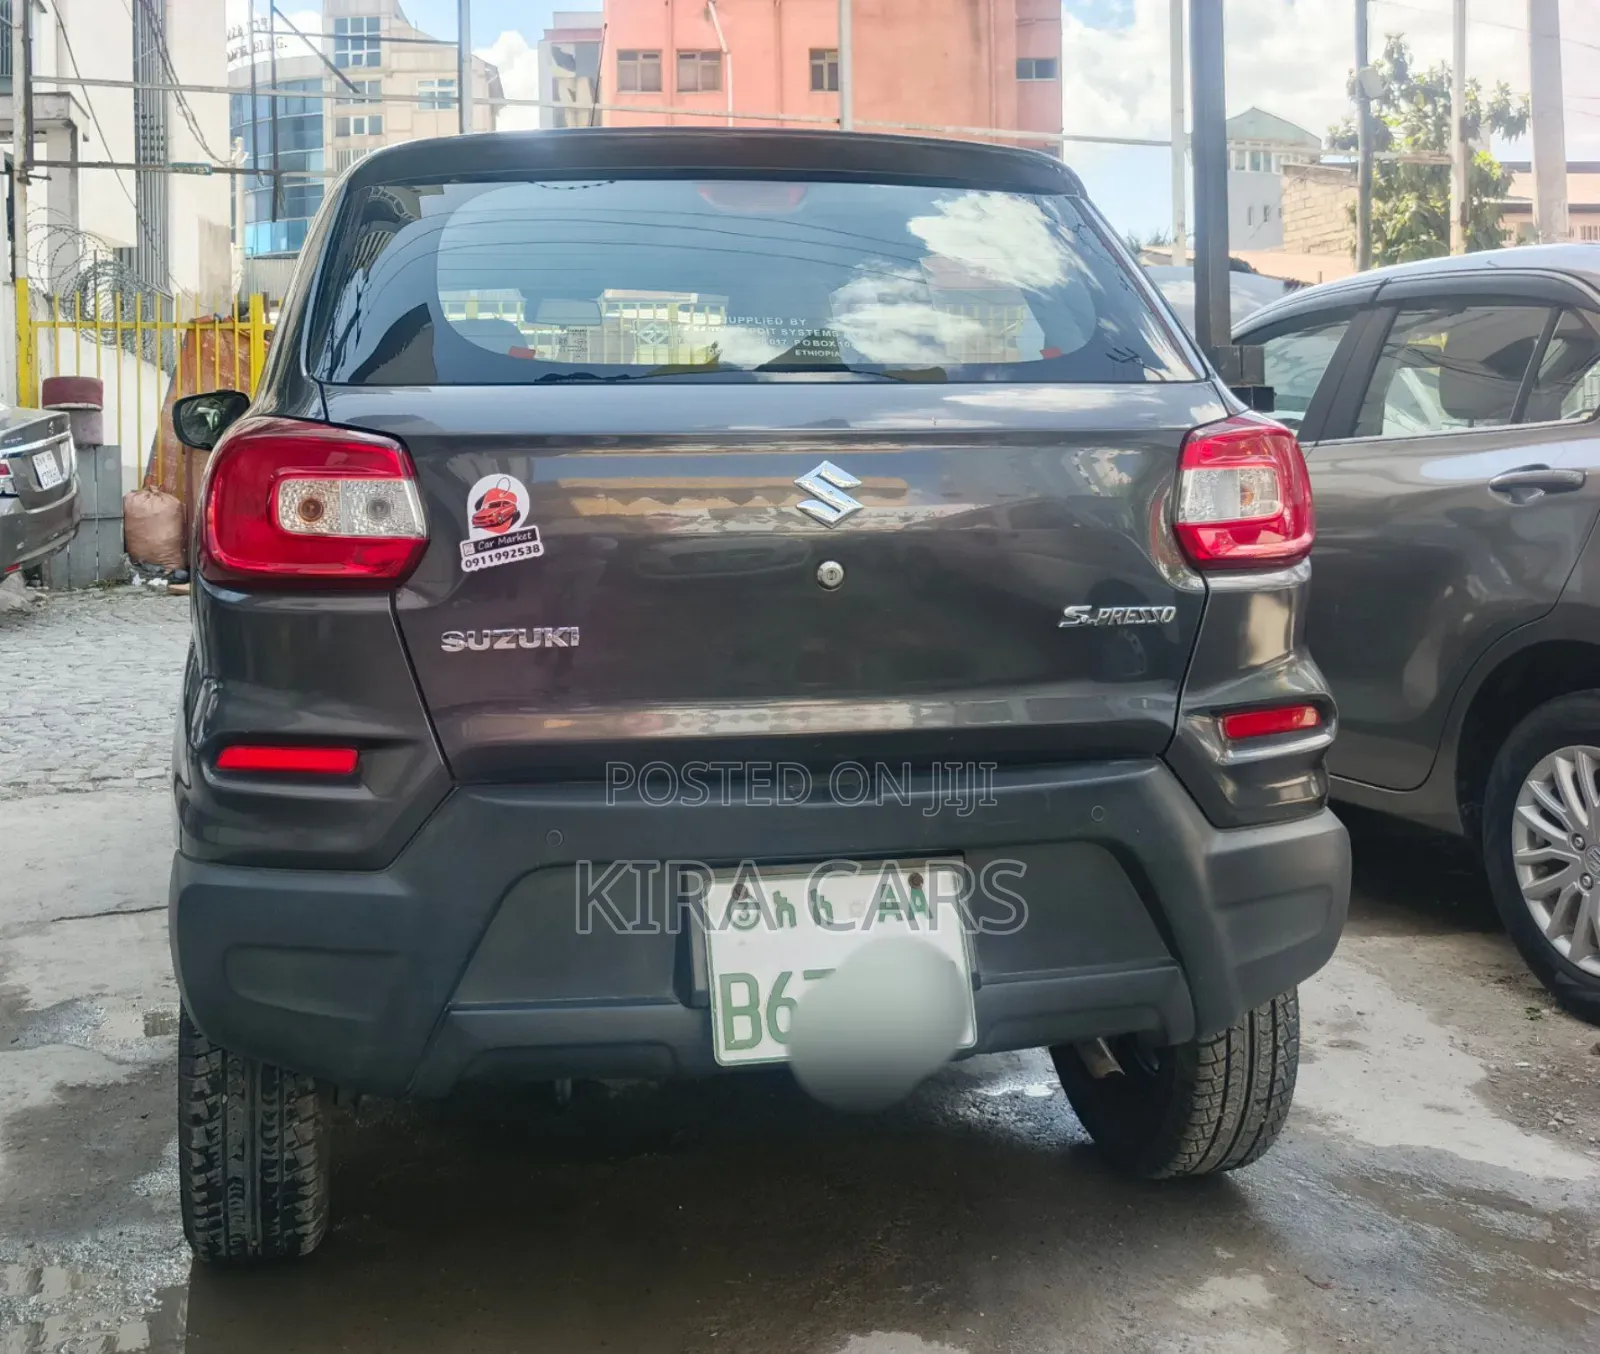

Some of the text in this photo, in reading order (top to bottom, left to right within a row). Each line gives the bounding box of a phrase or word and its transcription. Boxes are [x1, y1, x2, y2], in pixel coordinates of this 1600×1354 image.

[795, 349, 841, 358] ETHIOPIA
[478, 531, 533, 551] Car Market
[465, 543, 541, 569] 0911992538
[440, 626, 581, 653] SUZUKI
